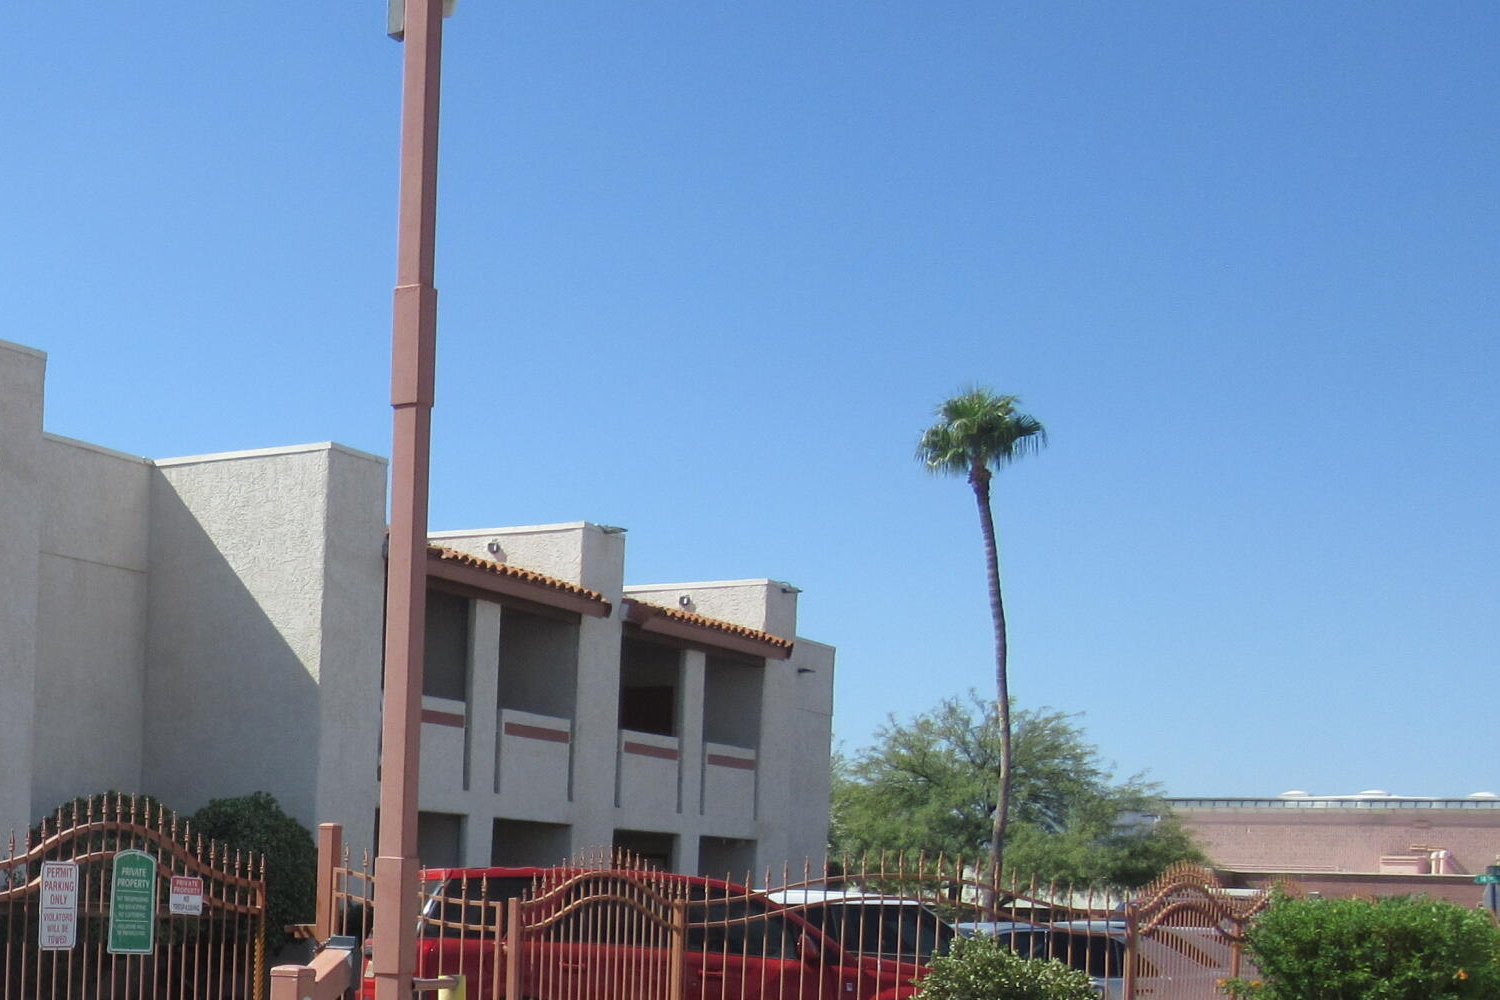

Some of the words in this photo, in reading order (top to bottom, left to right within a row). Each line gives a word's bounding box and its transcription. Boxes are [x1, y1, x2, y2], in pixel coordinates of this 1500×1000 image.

[46, 867, 73, 878] PERMIT
[121, 867, 147, 877] PRIVATE
[44, 881, 74, 892] PARKING
[117, 878, 150, 889] PROPERTY
[176, 879, 198, 887] PRIVATE
[50, 894, 68, 905] ONLY
[183, 895, 190, 903] NO
[172, 903, 200, 911] TRESPASSING
[43, 912, 74, 922] VIOLATORS
[47, 924, 60, 933] WILL
[61, 924, 68, 933] BE
[48, 936, 67, 944] TOWED
